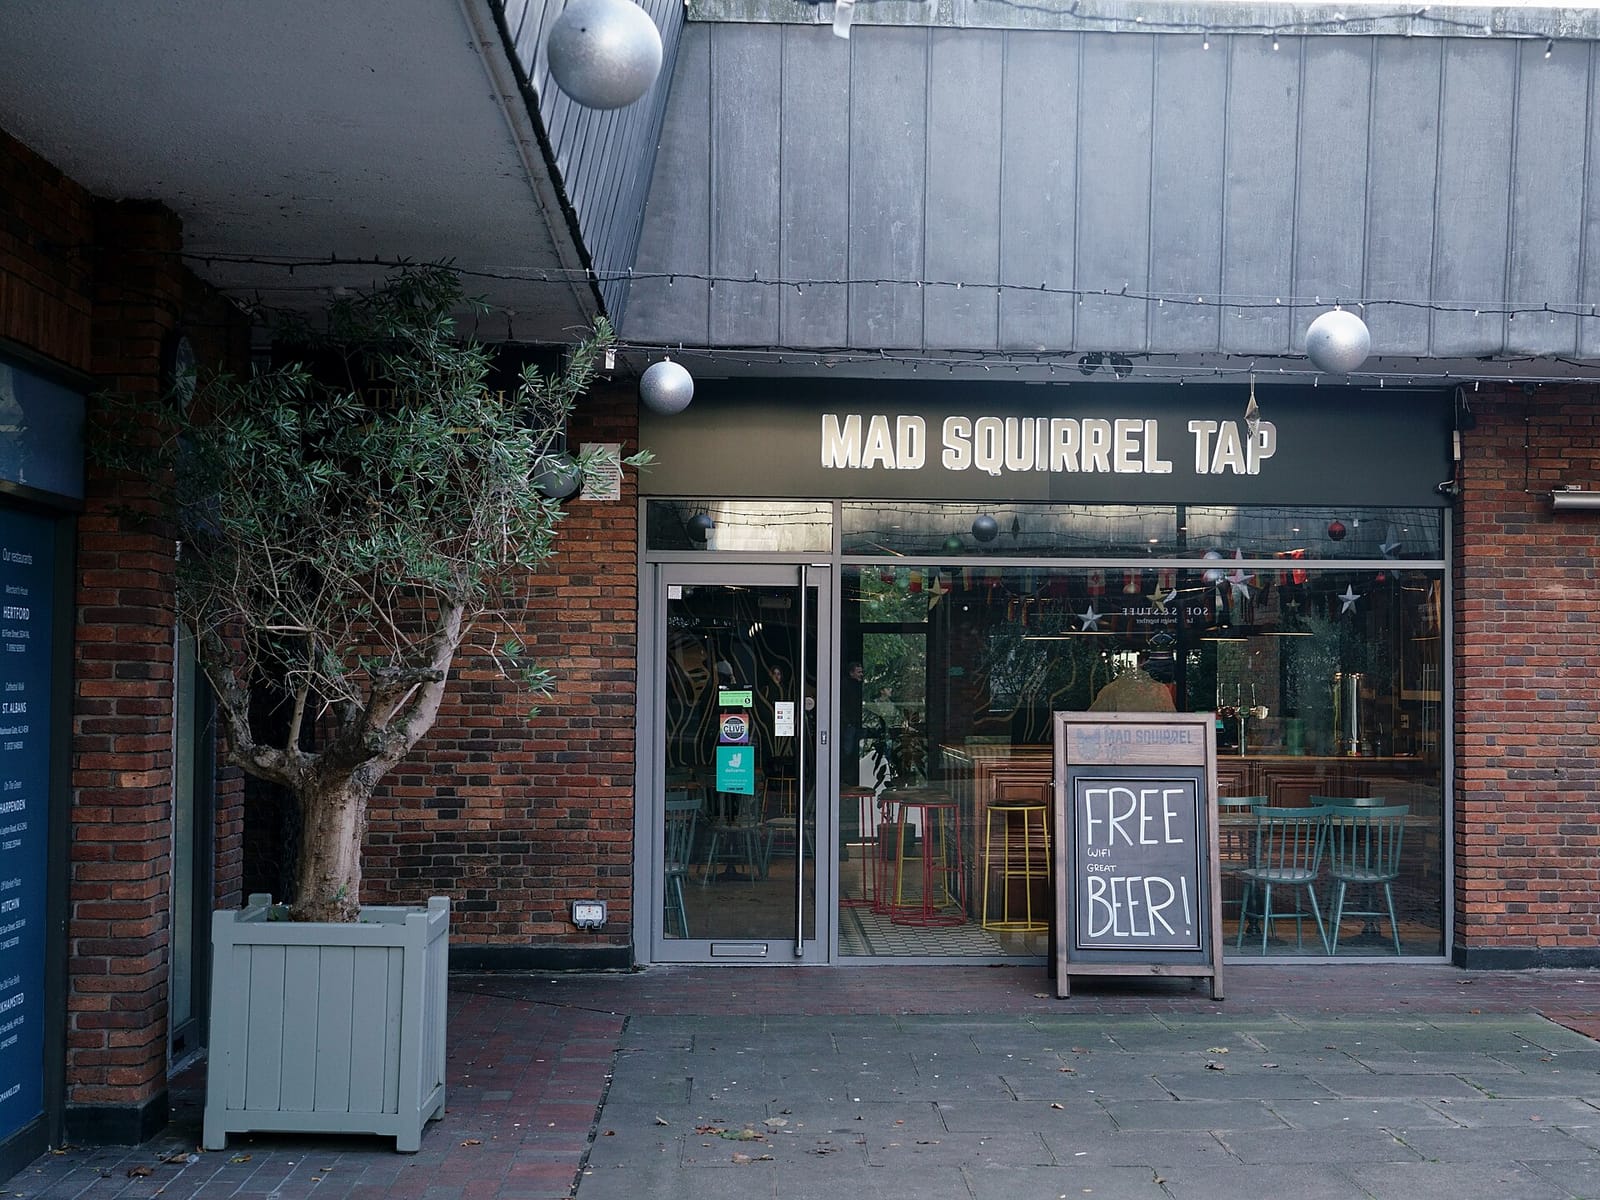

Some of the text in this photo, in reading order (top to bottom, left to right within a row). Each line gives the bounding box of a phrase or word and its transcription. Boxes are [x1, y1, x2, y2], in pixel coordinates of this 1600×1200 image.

[821, 414, 1277, 476] MAD SQUIRREL TAP
[3, 607, 29, 620] HERTFORD
[9, 702, 27, 713] ALBANS
[723, 725, 745, 733] CLIVE
[1103, 729, 1131, 744] MAD
[1085, 787, 1185, 846] FREE
[1086, 863, 1117, 873] GREAT
[1087, 876, 1192, 938] BEER!
